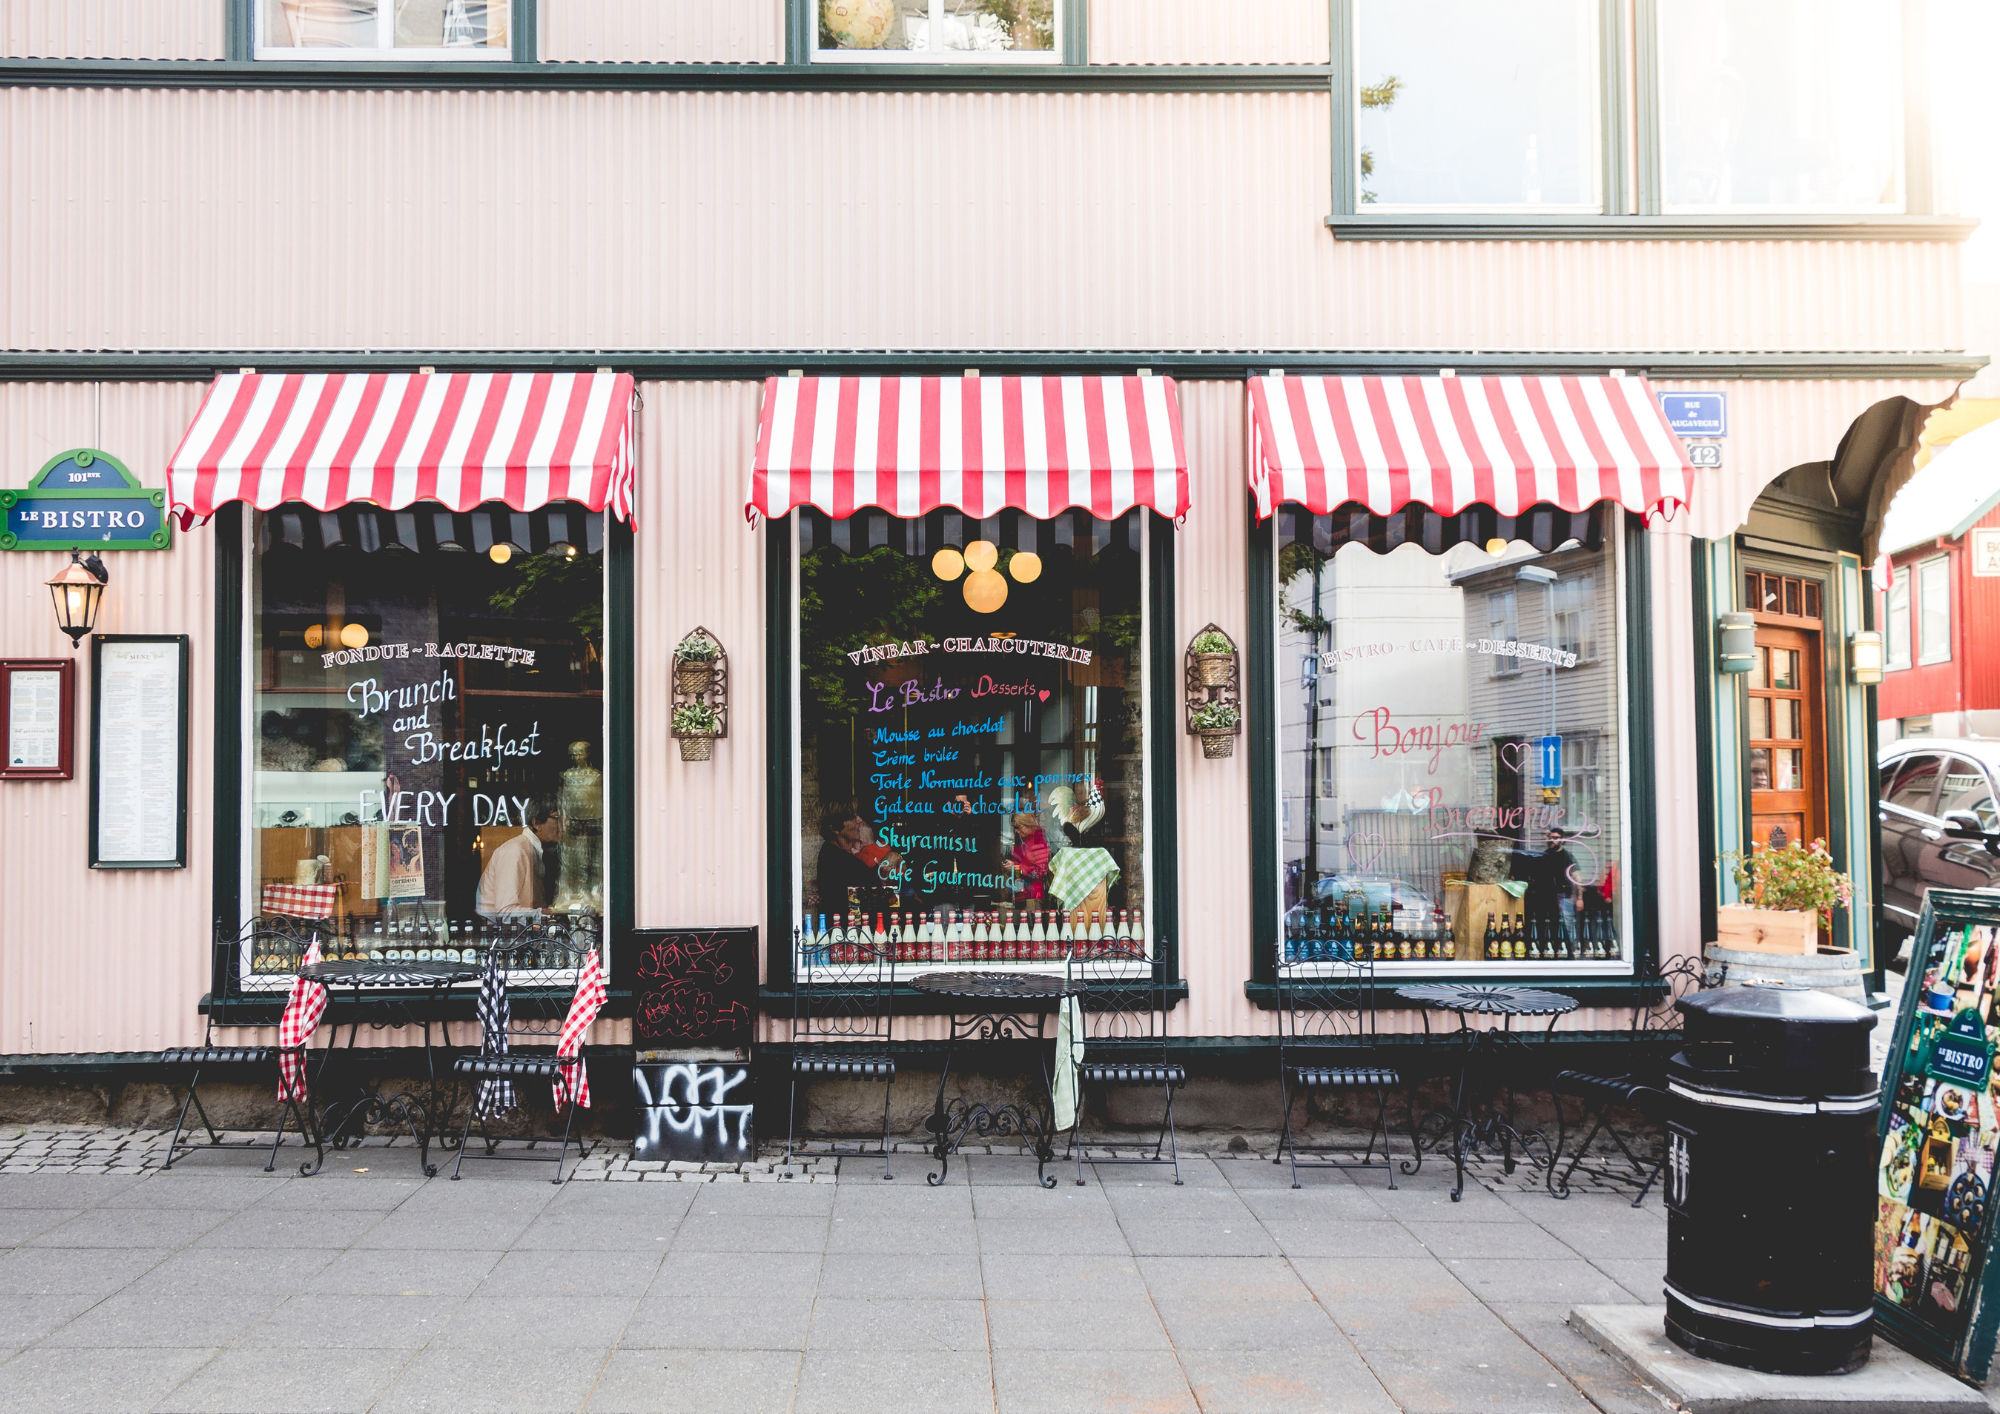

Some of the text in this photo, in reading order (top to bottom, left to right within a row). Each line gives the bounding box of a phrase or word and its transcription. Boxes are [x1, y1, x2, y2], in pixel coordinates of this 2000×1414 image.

[1692, 447, 1716, 464] 12
[20, 510, 145, 529] LE BISTRO
[322, 643, 409, 669] FONDUE
[425, 642, 537, 666] RACLETTE
[847, 640, 930, 666] VÍNBAR
[943, 637, 1093, 666] CHARCUTERIE
[1322, 641, 1394, 668] BISTRO
[1411, 635, 1462, 652] CAFÉ
[1478, 639, 1577, 668] DESSERTS
[347, 670, 456, 719] Brunch
[866, 674, 1036, 712] Le Bistro Desserts
[392, 705, 430, 732] and
[873, 716, 1005, 744] Mousse au chocolat
[404, 721, 542, 772] Breakfast
[1353, 706, 1491, 775] Bonjour
[872, 750, 916, 767] Crème
[870, 770, 1092, 796] Torte Normande aux pommes
[359, 789, 530, 828] EVERY DAY
[873, 791, 1044, 823] Gateau au chocolat
[1411, 786, 1566, 834] Bienvenue
[876, 859, 1022, 894] Café Gourmand
[1944, 1048, 1984, 1070] BISTRO
